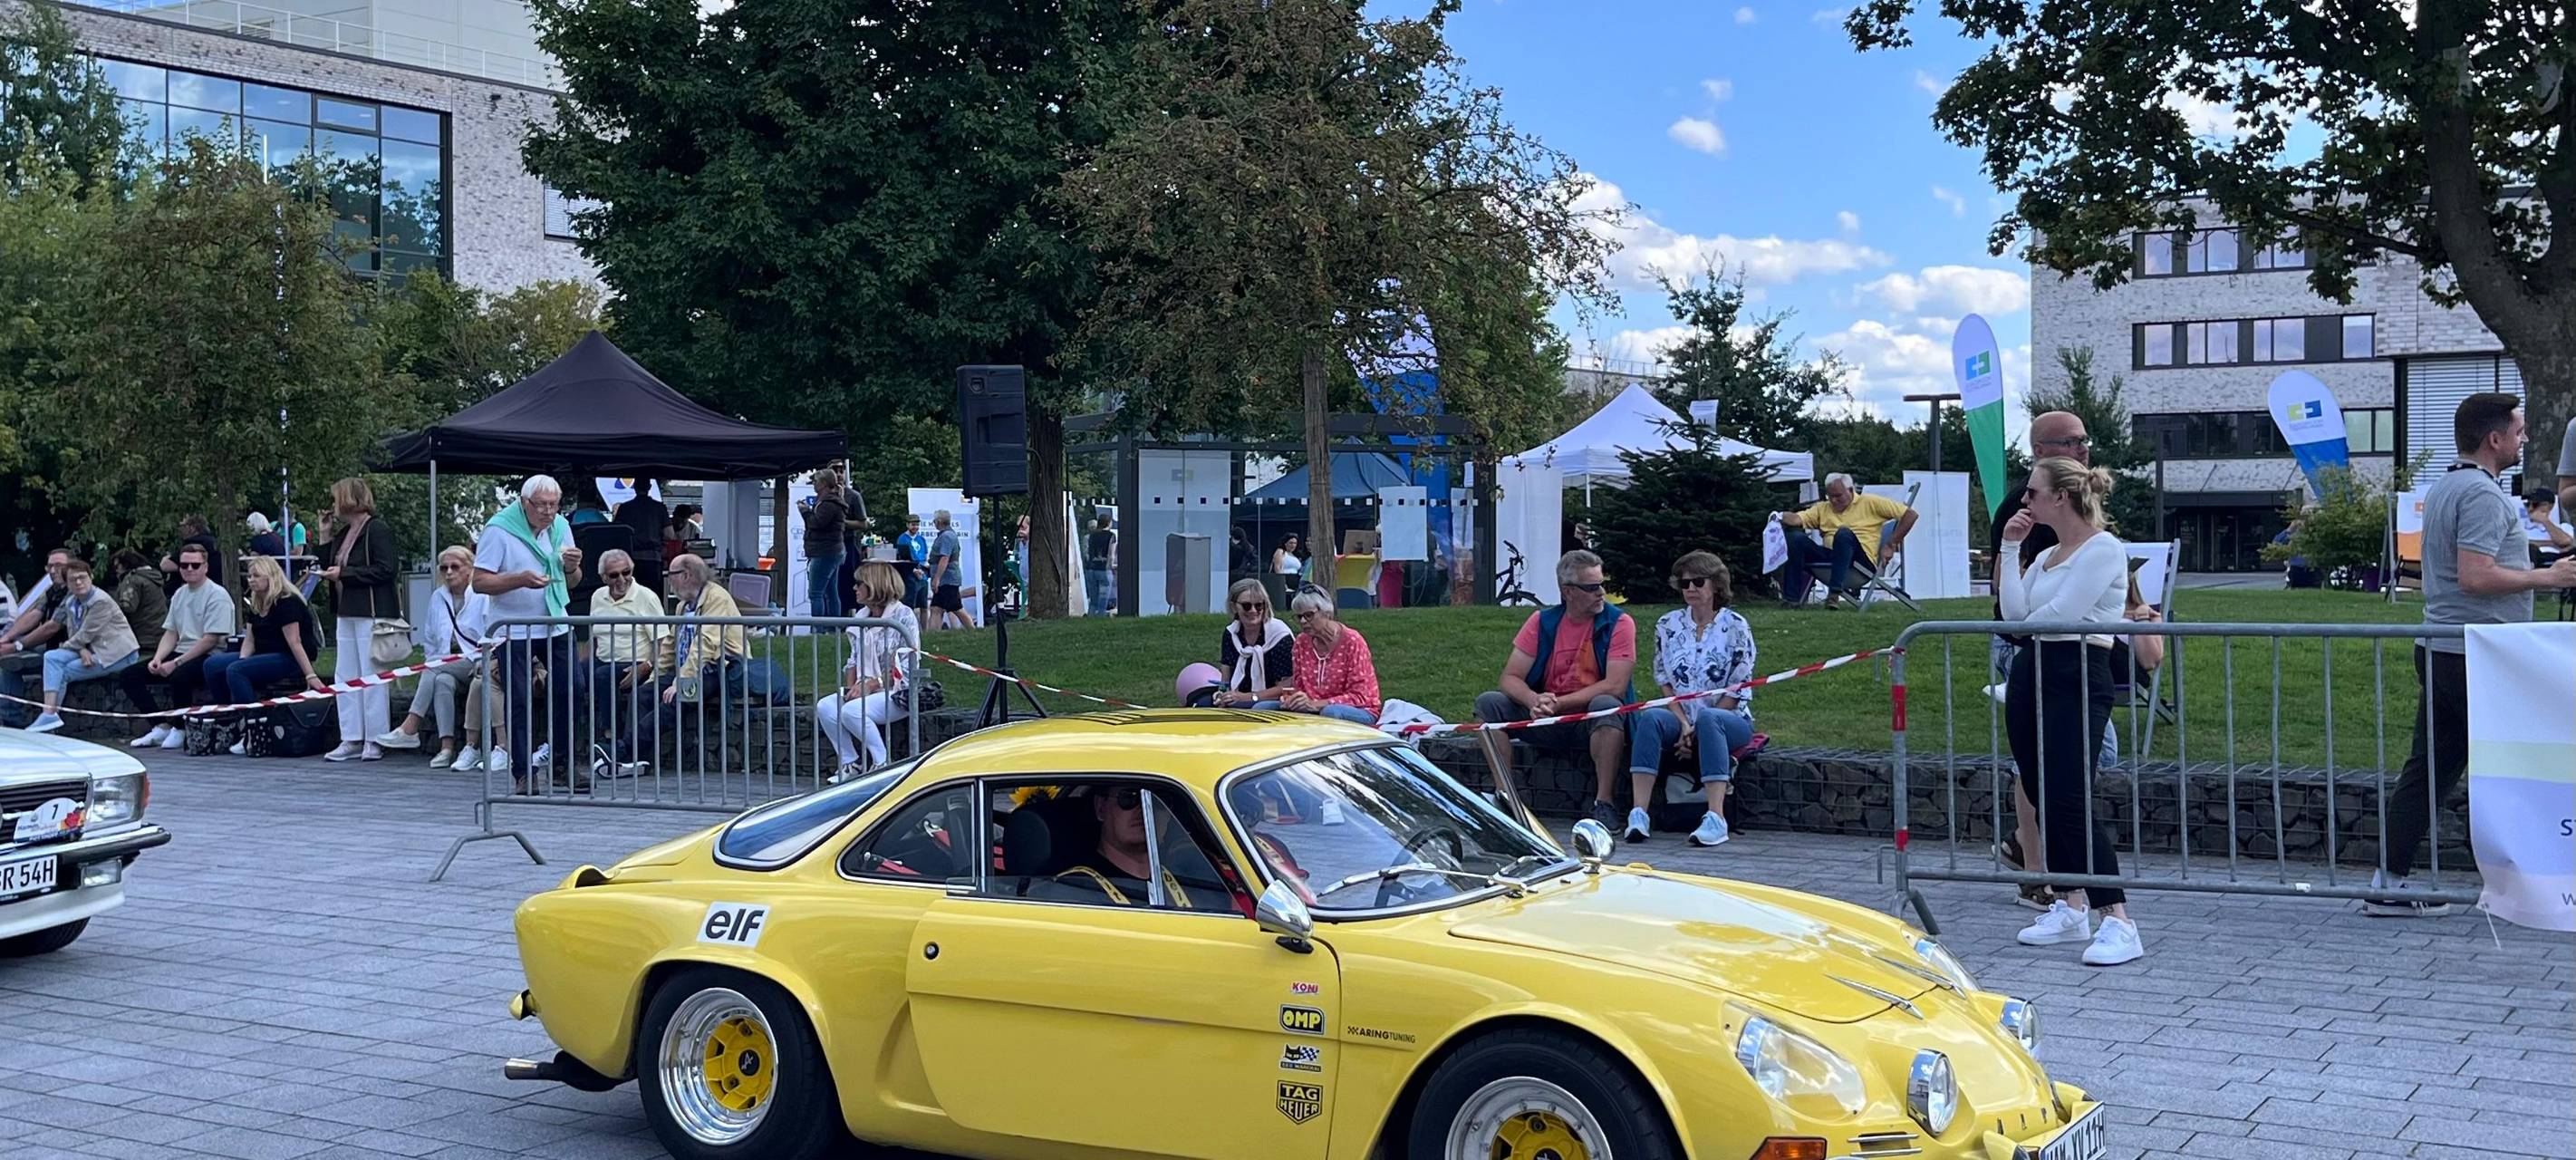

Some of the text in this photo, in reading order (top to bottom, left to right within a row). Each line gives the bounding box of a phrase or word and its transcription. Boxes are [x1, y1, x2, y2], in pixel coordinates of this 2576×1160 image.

[52, 804, 59, 820] 7
[20, 858, 54, 888] 54H
[705, 908, 765, 942] elf
[1292, 982, 1318, 993] KONI
[1283, 1010, 1321, 1029] OMP
[1281, 1084, 1318, 1100] TAG
[1279, 1098, 1319, 1121] HEUER
